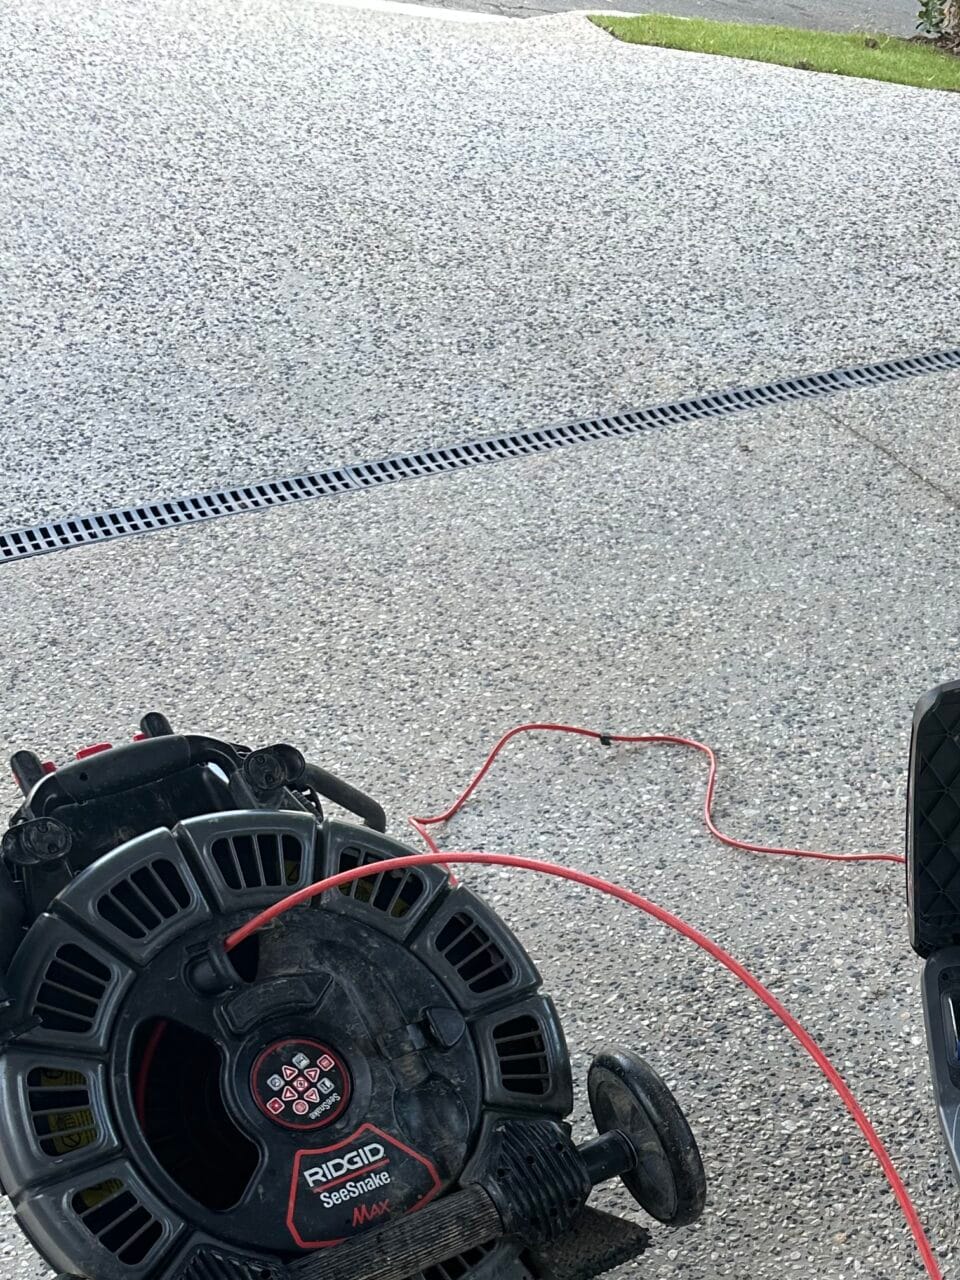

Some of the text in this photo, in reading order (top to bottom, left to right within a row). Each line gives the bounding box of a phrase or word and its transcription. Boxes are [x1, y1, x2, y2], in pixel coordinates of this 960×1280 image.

[308, 1092, 341, 1120] SeeSnake
[303, 1143, 385, 1187] RIDGID
[320, 1171, 391, 1208] SeeSnake
